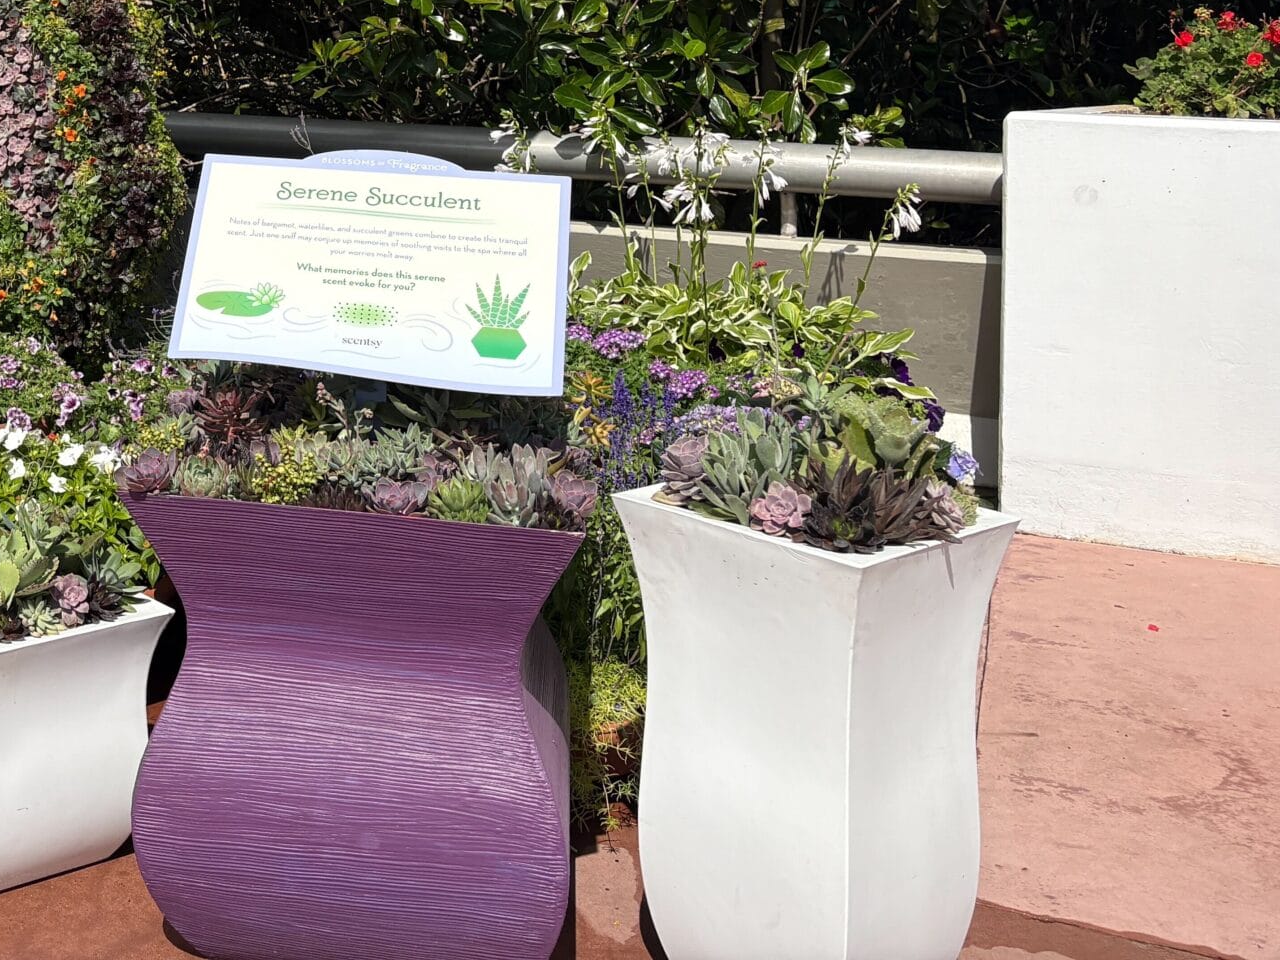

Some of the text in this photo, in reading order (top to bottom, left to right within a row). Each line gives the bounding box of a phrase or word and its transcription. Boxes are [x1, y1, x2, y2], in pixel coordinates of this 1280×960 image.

[321, 157, 375, 167] BLOSSOMS
[387, 158, 448, 172] Fragrance
[276, 181, 481, 211] Serene Succulent
[229, 217, 251, 226] Notes
[253, 218, 261, 226] of
[337, 225, 351, 233] and
[353, 226, 387, 235] succulent
[388, 230, 413, 238] greens
[415, 231, 447, 240] combine
[448, 233, 457, 241] to
[483, 235, 497, 244] this
[499, 237, 528, 247] tranquil
[249, 229, 265, 238] Just
[281, 232, 297, 240] sniff
[313, 236, 341, 245] conjure
[353, 239, 389, 247] memories
[391, 239, 400, 248] of
[401, 241, 432, 252] soothing
[433, 244, 452, 252] visits
[454, 245, 462, 253] to
[463, 245, 476, 253] the
[477, 247, 491, 255] spa
[493, 248, 517, 256] where
[518, 249, 527, 257] all
[330, 248, 346, 256] your
[376, 250, 393, 258] melt
[297, 261, 446, 283] What memories does this serene
[322, 278, 416, 292] scent evoke for you?
[342, 337, 383, 349] scentsy
